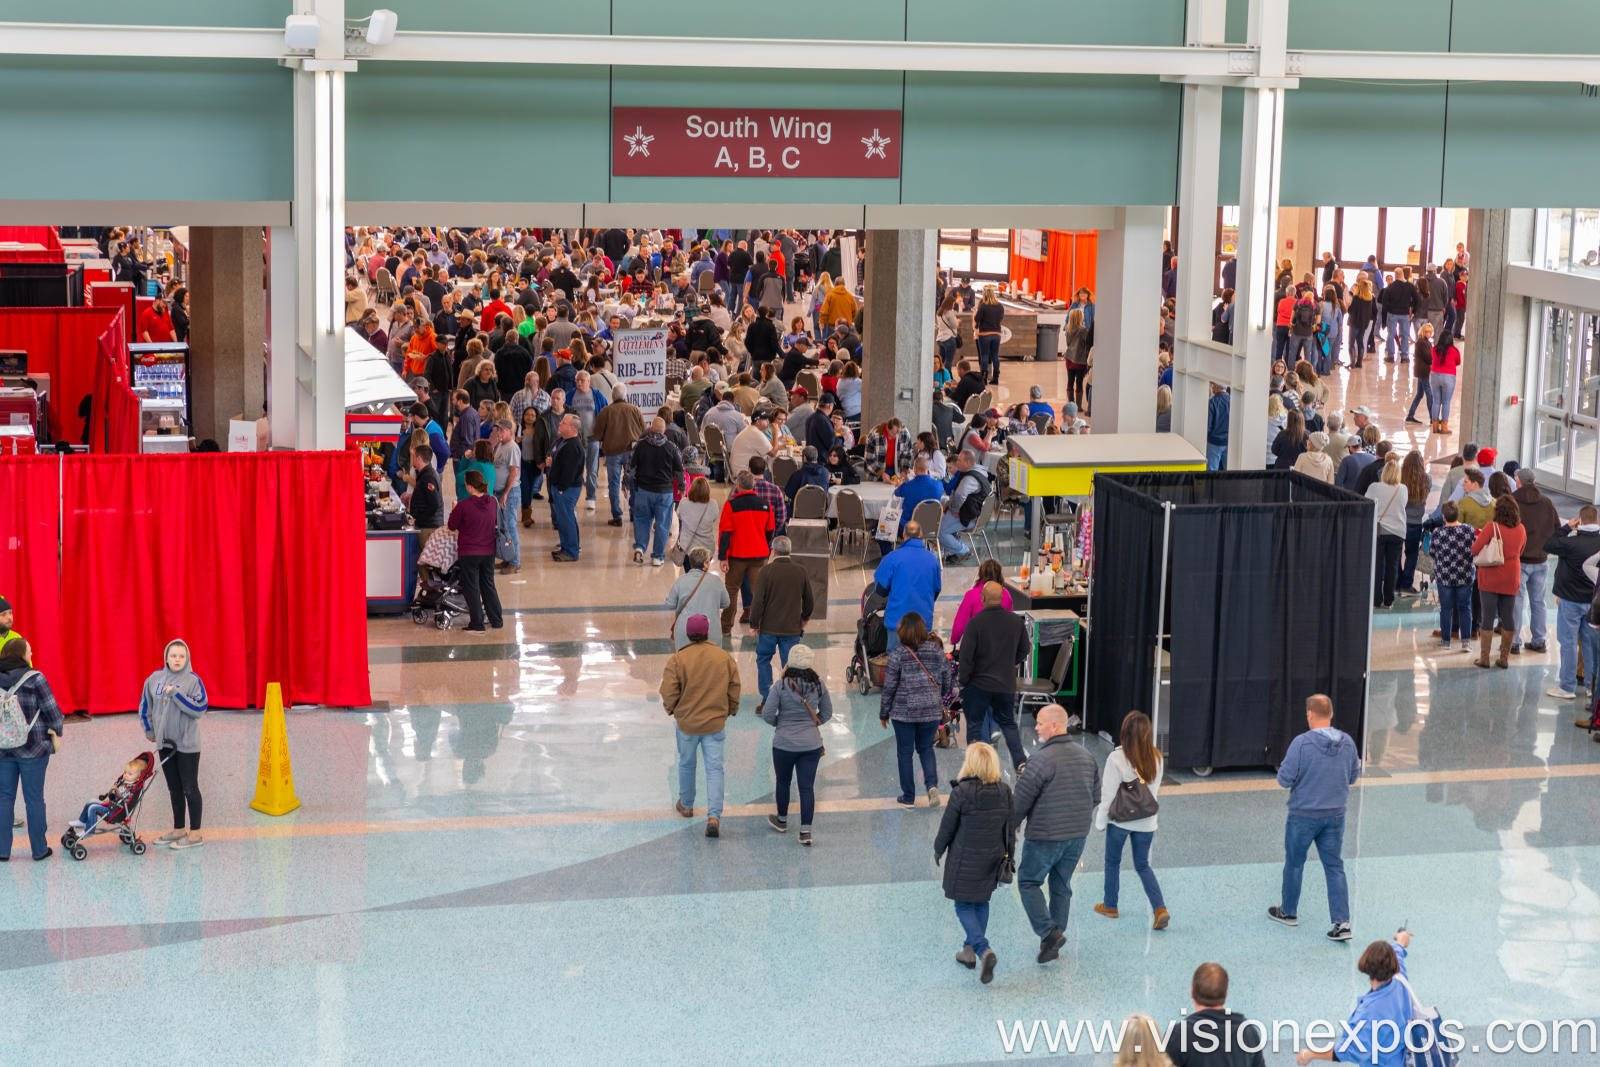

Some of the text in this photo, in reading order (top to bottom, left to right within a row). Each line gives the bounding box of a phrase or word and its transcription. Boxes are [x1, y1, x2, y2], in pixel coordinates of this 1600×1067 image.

[686, 114, 832, 145] South Wing
[714, 145, 801, 173] A, B, C
[617, 362, 664, 377] RIB-EYE
[624, 392, 664, 408] MBURGERS
